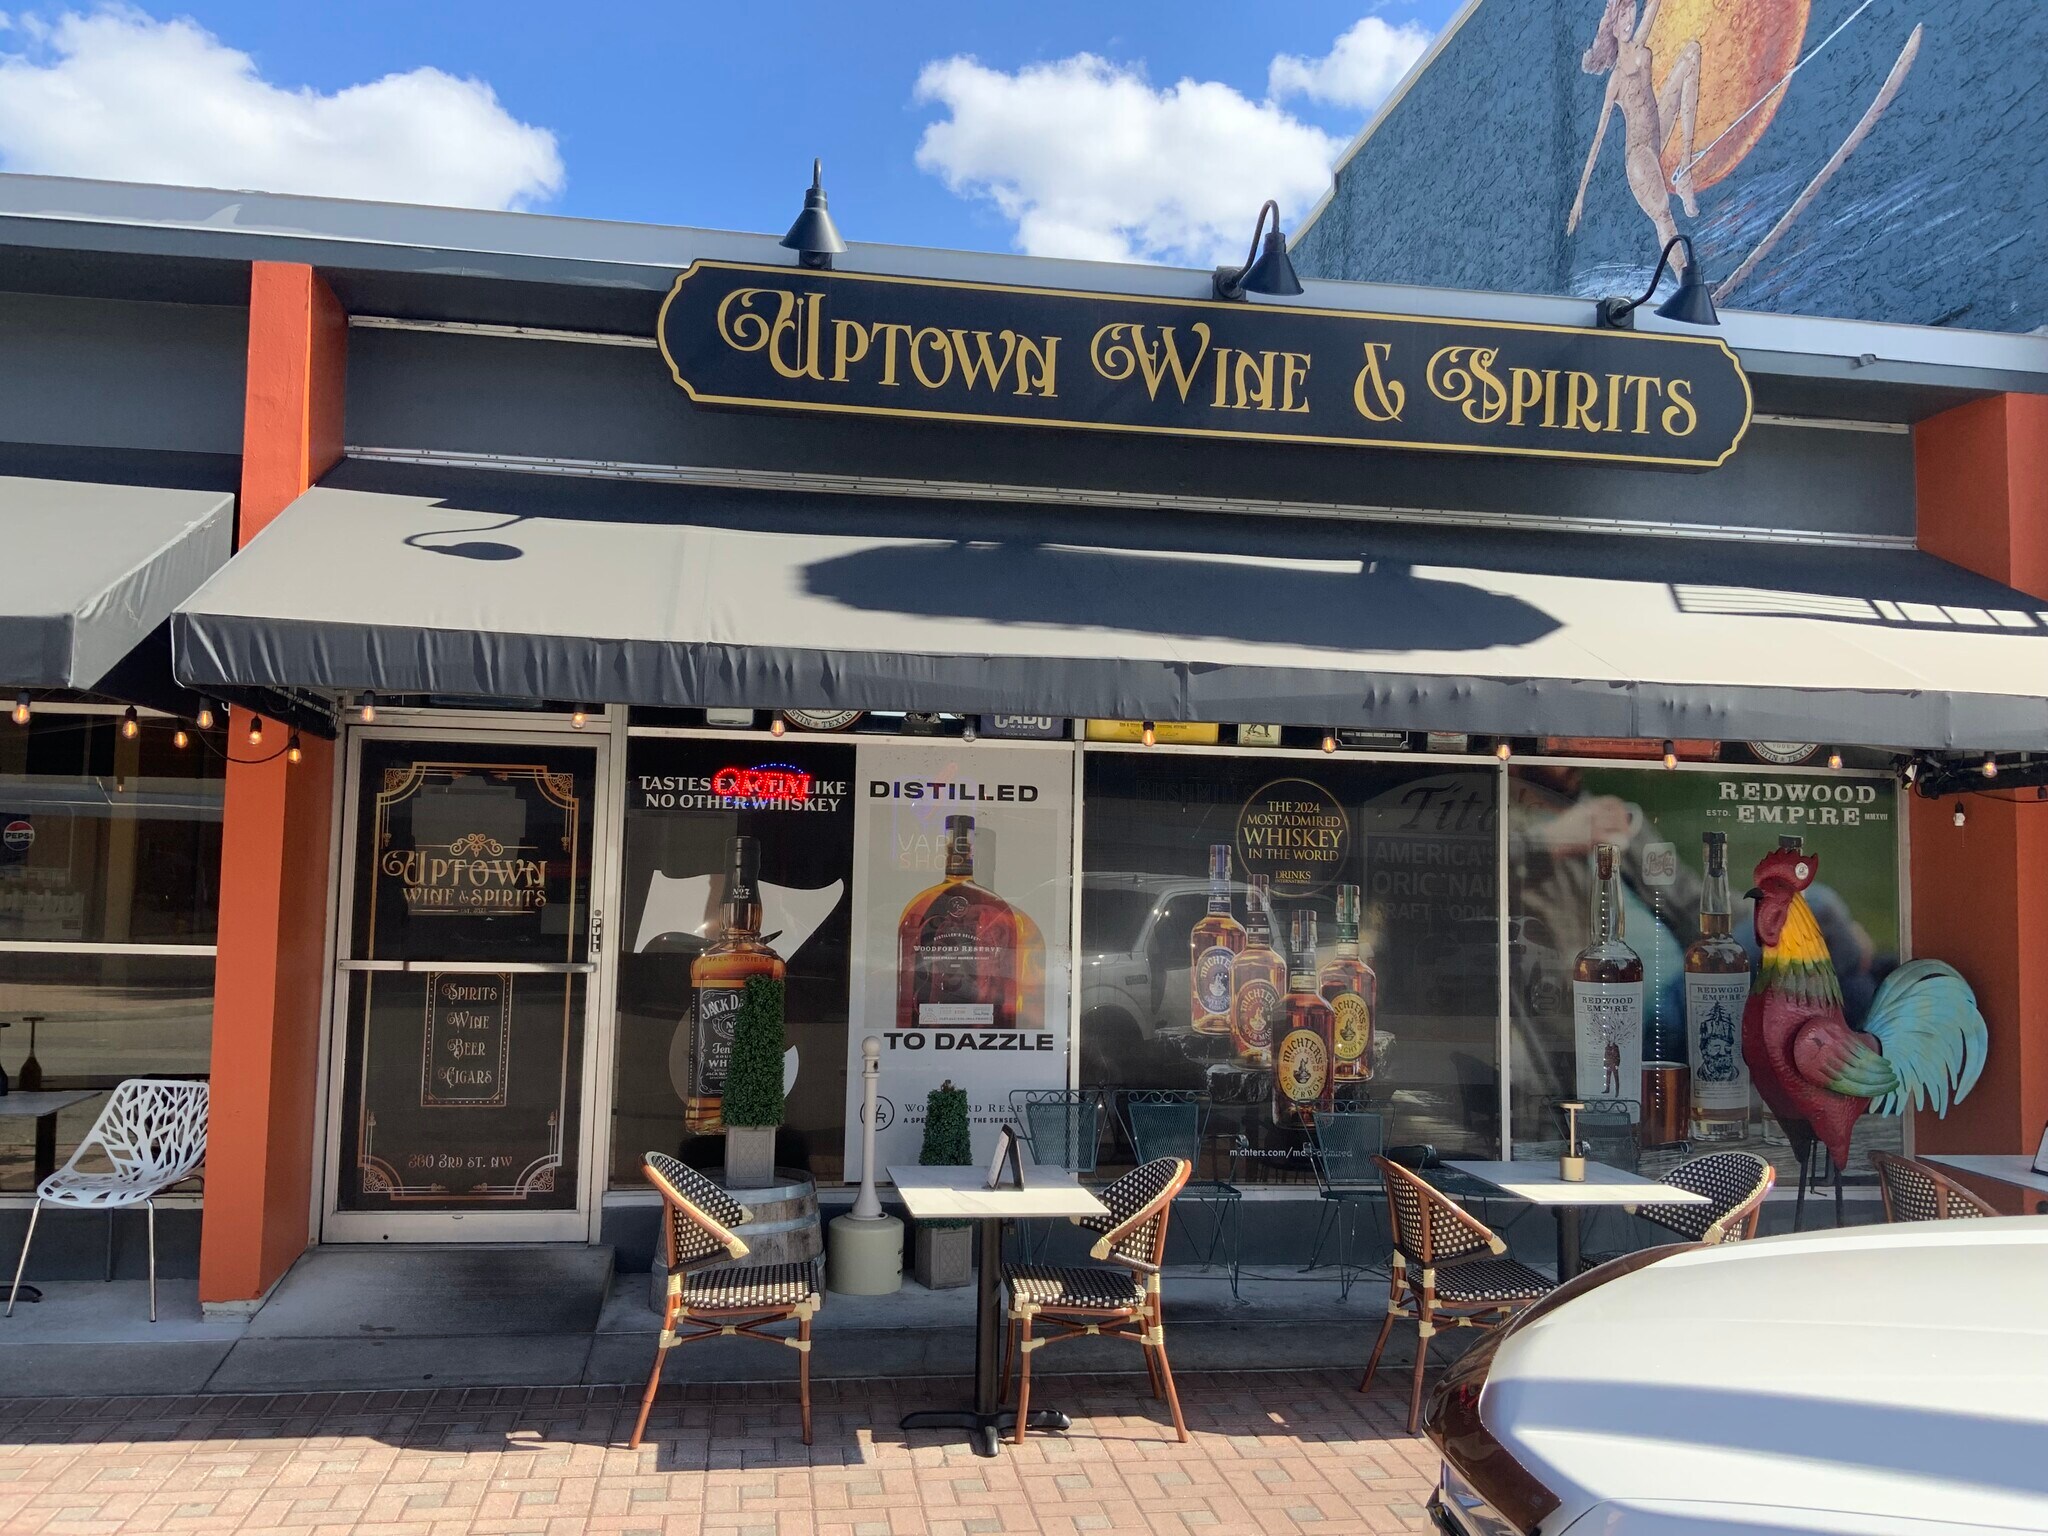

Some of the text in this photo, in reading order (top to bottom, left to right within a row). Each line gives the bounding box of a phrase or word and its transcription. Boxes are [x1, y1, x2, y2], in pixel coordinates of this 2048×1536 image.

[717, 286, 1697, 437] UPTOWN WINE & SPIRITS
[790, 711, 853, 727] STIN TEXAS
[1787, 744, 1813, 762] TEXAS
[638, 776, 712, 792] TASTES
[803, 780, 848, 796] LIKE
[869, 780, 1039, 802] DISTILLED
[1718, 781, 1877, 804] REDWOOD
[645, 793, 841, 812] NO OTHER WHISKEY
[1267, 801, 1321, 813] THE 2024
[1247, 814, 1341, 828] MOST ADMIRED
[1706, 810, 1731, 818] ESTD.
[1735, 804, 1861, 826] EMPIRE
[5, 832, 33, 840] PEPSI
[1243, 826, 1344, 848] WHISKEY
[1248, 848, 1339, 862] IN THE WORLD
[382, 851, 548, 888] UPTOWN
[1275, 870, 1311, 880] DRINKS
[402, 887, 547, 907] WINE & SPIRITS
[592, 918, 601, 952] PULL
[442, 983, 498, 1004] SPIRITS
[1697, 986, 1745, 994] REDWOOD
[1702, 993, 1741, 1001] EMPIRE
[701, 997, 728, 1020] JACK
[1582, 996, 1633, 1005] REDWOOD
[447, 1010, 490, 1033] WINE
[1334, 999, 1366, 1025] ICHTER'S
[447, 1038, 486, 1060] BEER
[883, 1032, 1054, 1051] TO DAZZLE
[1283, 1037, 1323, 1065] MICHTER'S
[438, 1066, 493, 1088] CIGARS
[1282, 1076, 1324, 1098] BOURBON
[989, 1117, 1019, 1125] SENSES
[438, 1153, 463, 1168] 3RD
[467, 1156, 486, 1168] ST.
[490, 1156, 513, 1168] NW
